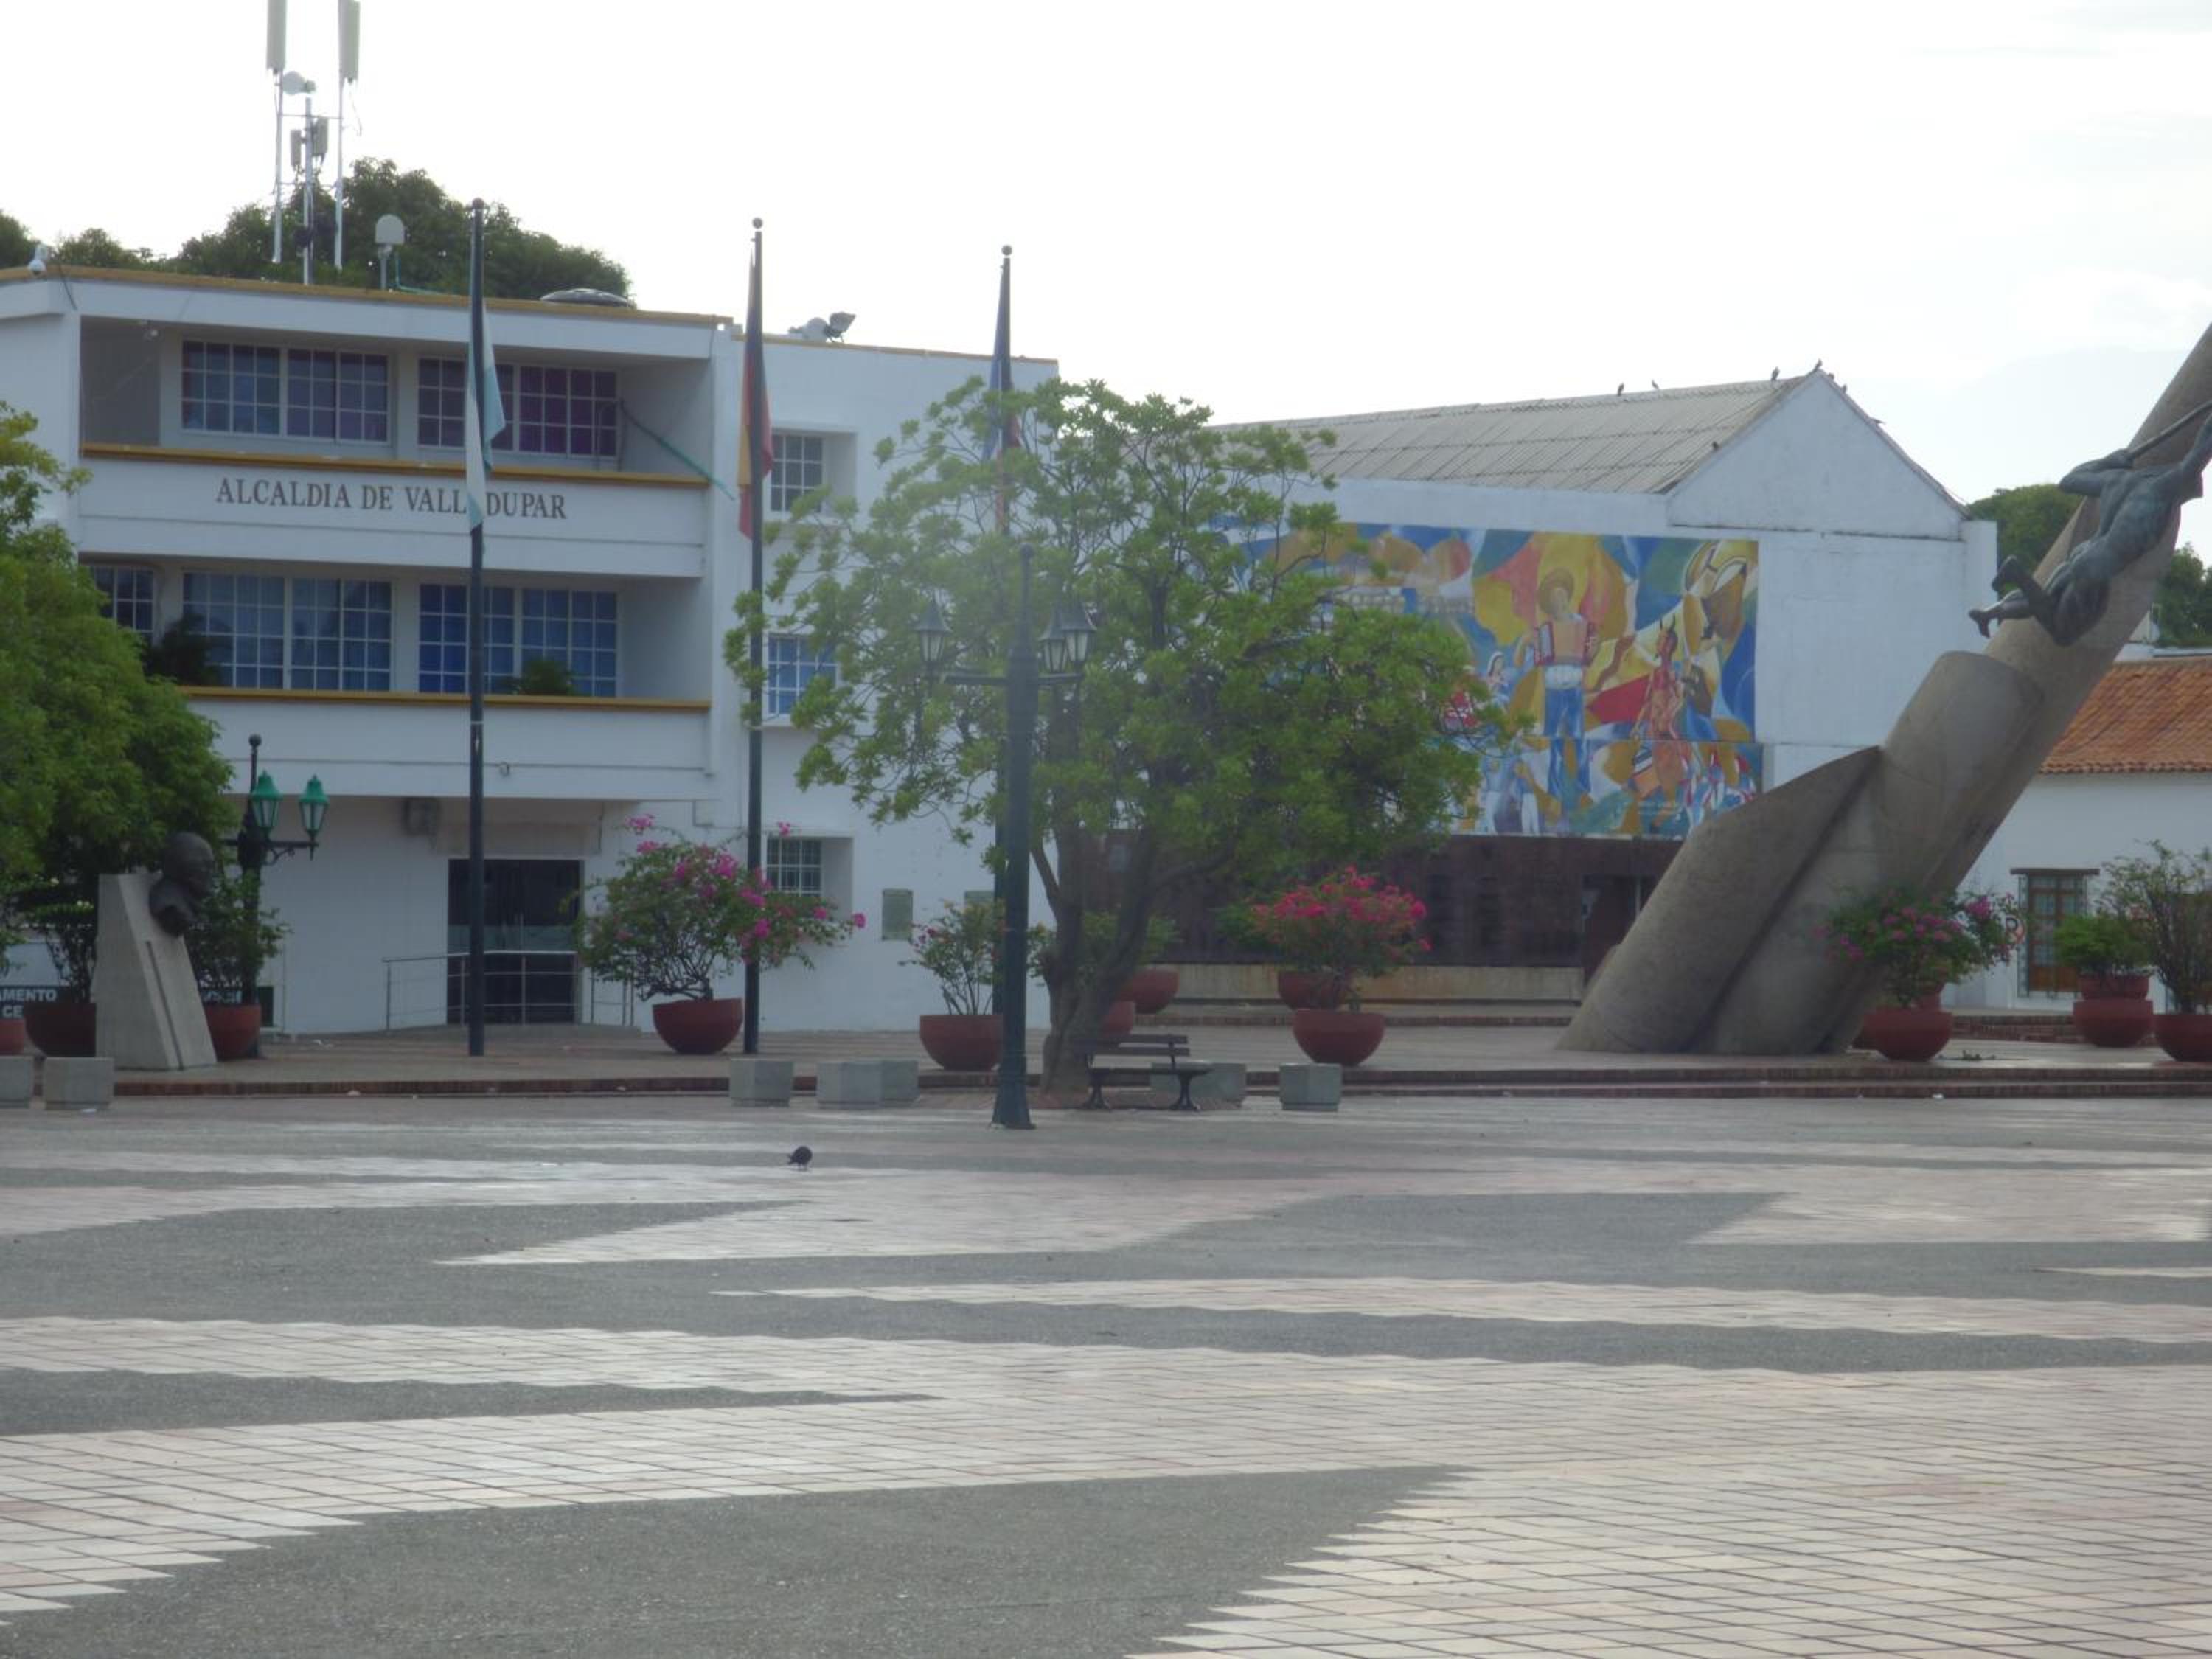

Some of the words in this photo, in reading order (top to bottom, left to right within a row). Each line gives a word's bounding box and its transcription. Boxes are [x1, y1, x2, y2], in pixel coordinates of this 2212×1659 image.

[215, 478, 352, 508] ALCALDIA
[361, 484, 394, 510] DE
[405, 486, 567, 520] VALLDUPAR
